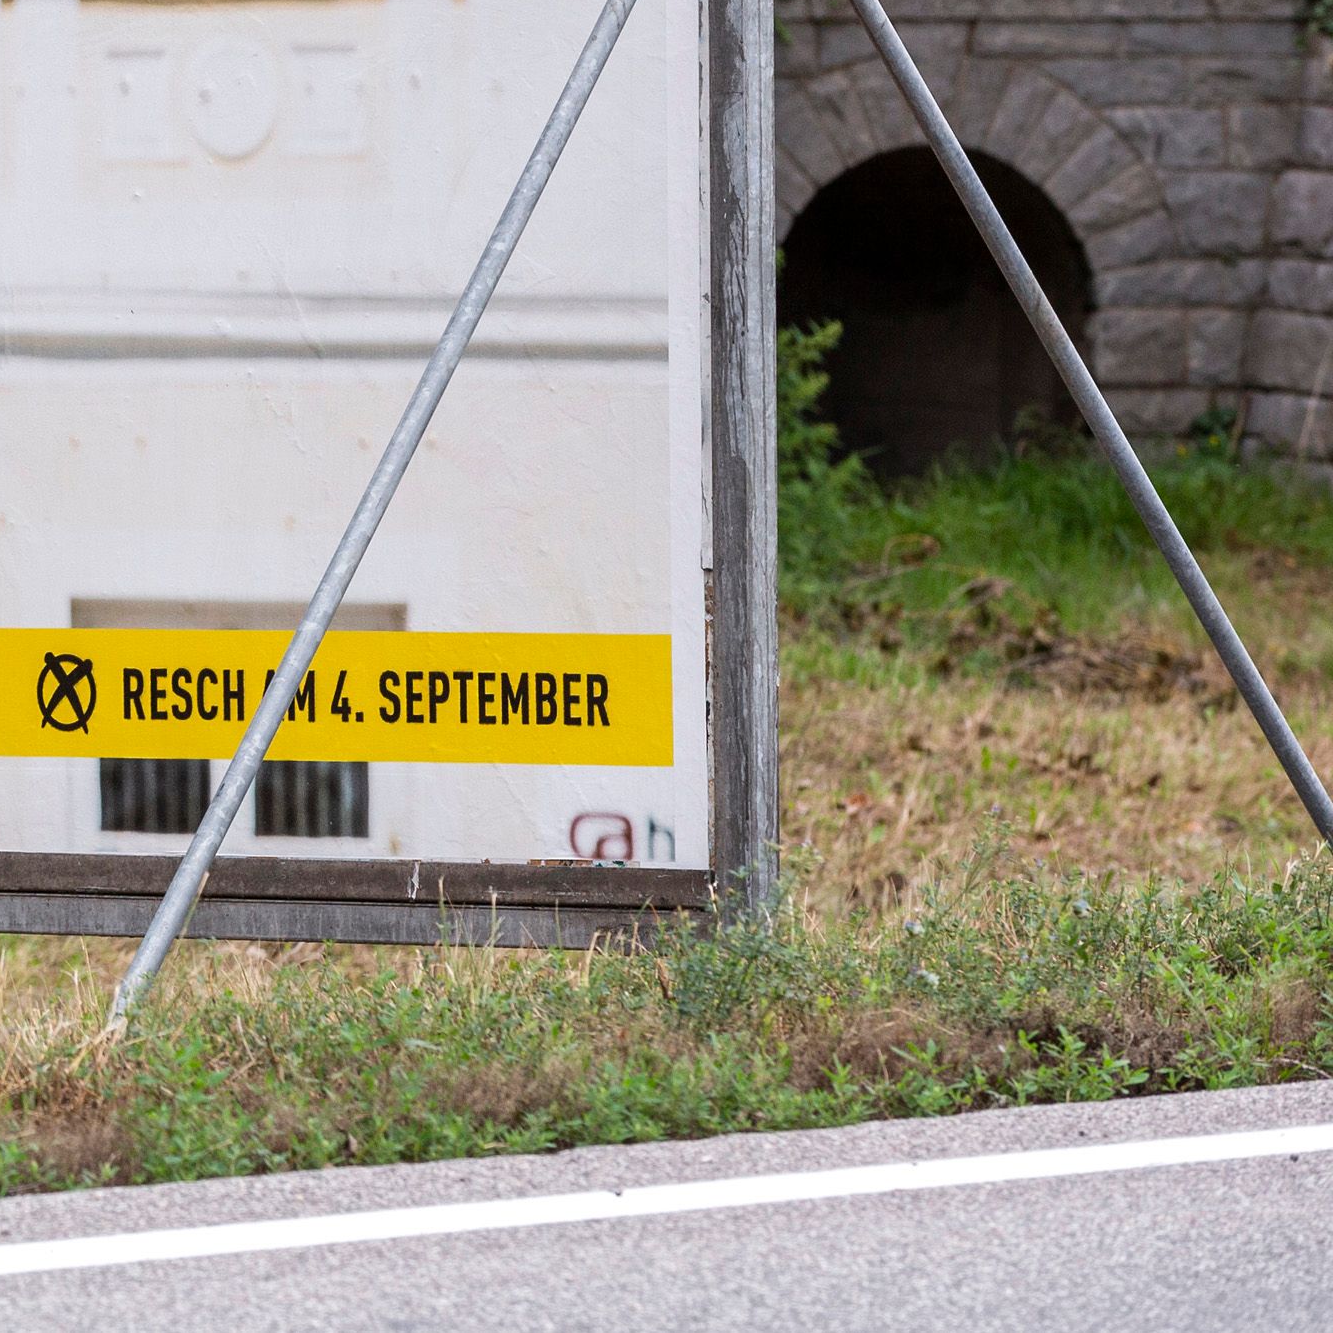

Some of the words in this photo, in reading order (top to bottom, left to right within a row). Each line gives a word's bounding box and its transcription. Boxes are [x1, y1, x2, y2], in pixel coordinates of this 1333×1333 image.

[123, 667, 245, 721] RESCH
[330, 670, 364, 723] 4.
[379, 670, 611, 726] SEPTEMBER
